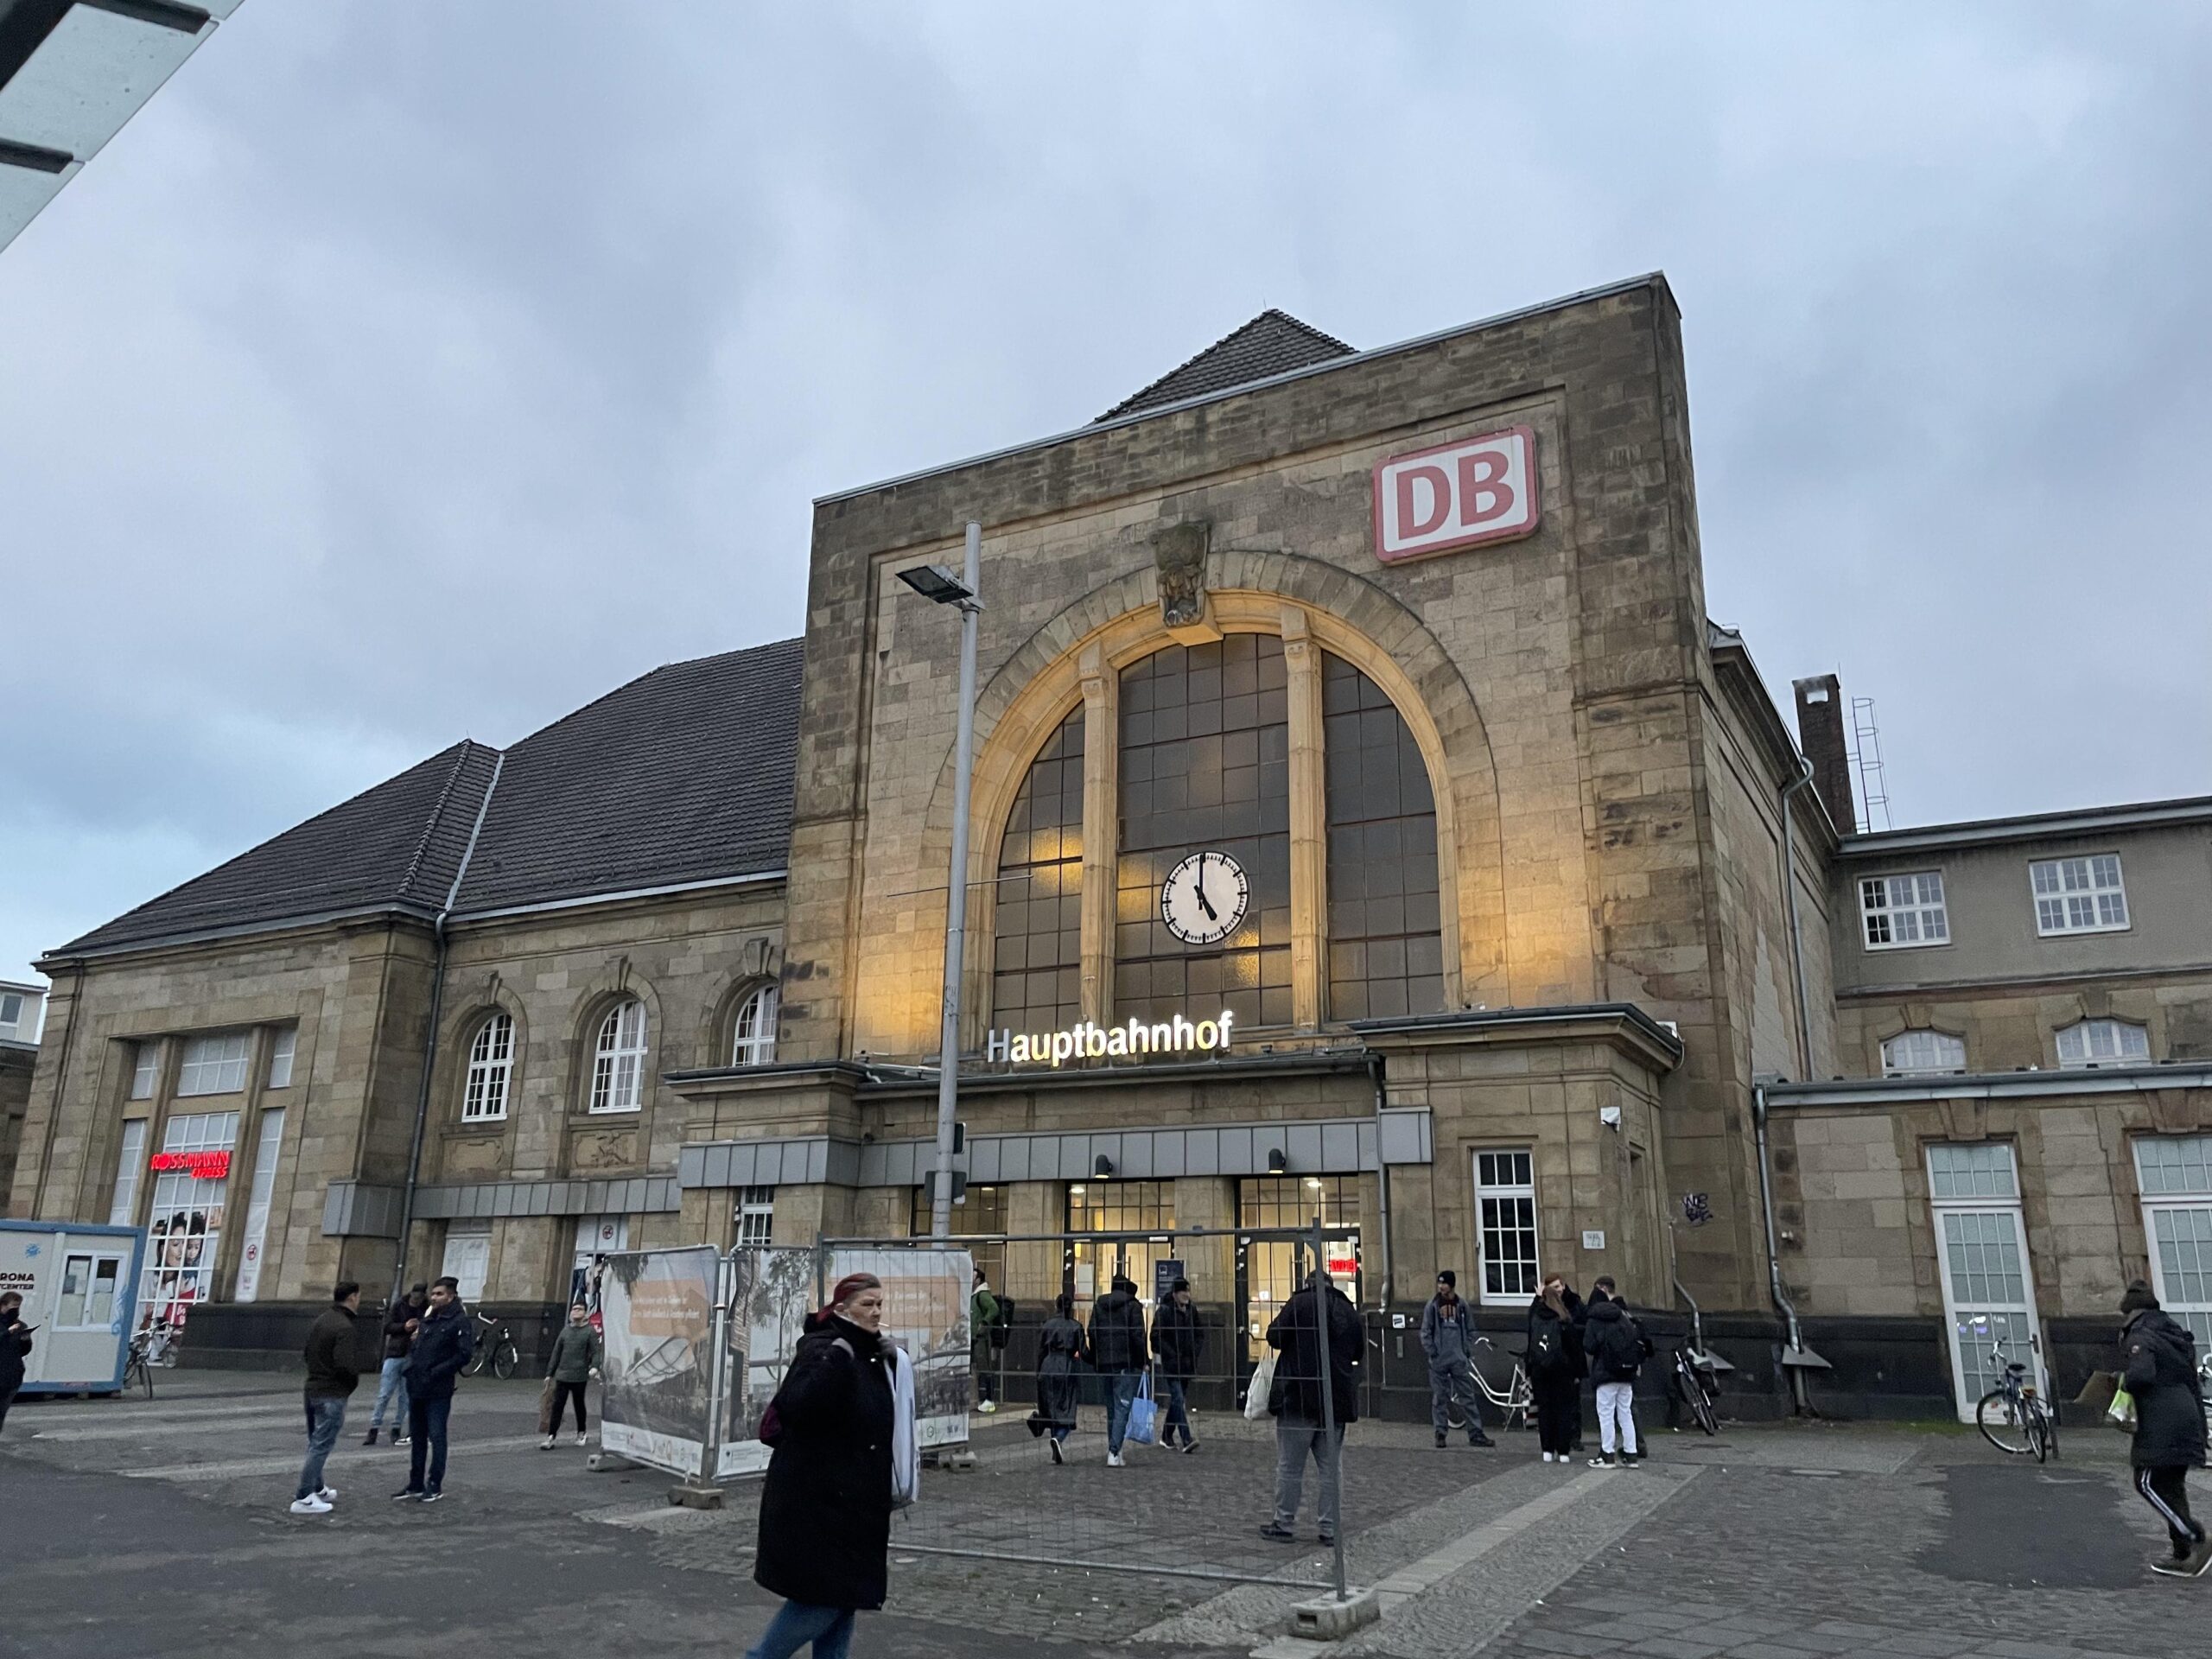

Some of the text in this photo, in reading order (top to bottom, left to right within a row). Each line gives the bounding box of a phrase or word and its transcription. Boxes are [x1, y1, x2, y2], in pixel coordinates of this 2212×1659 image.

[1396, 450, 1515, 541] DB
[988, 1009, 1234, 1068] Hauptbahnhof
[150, 1150, 230, 1171] ROSSMANN
